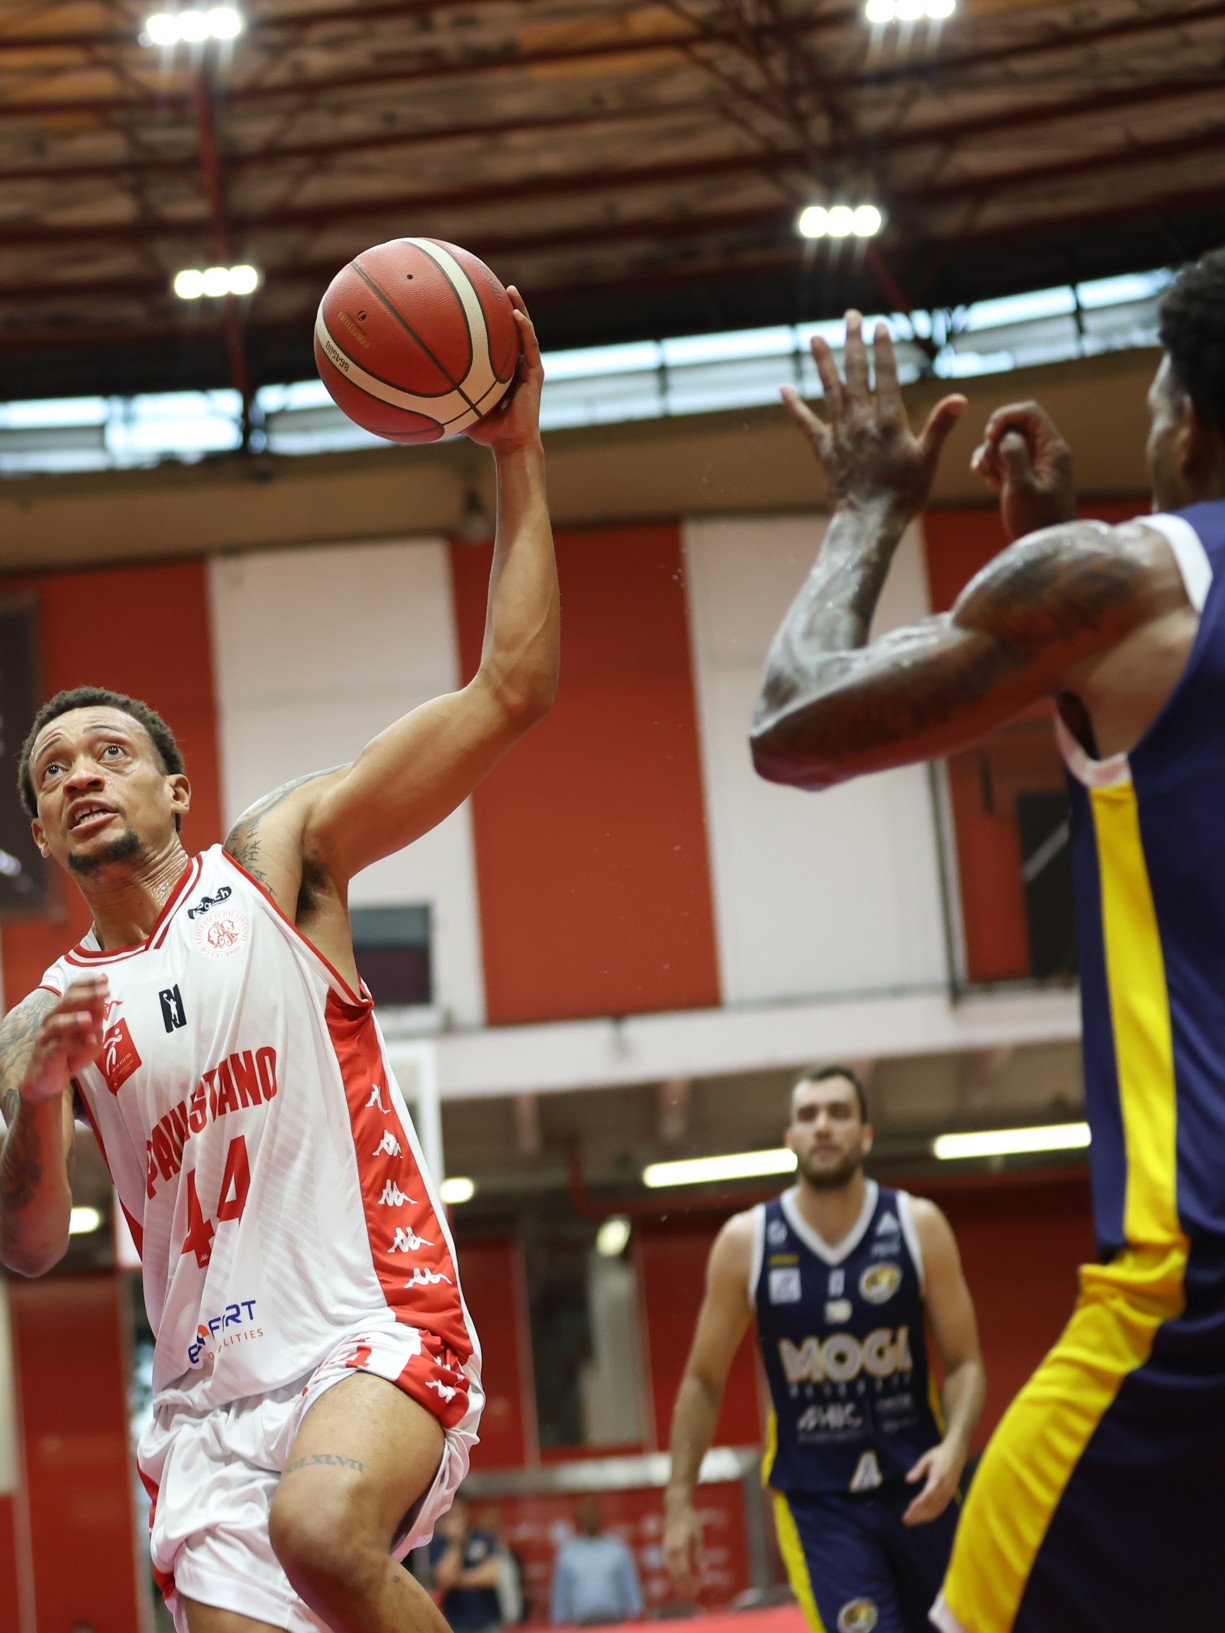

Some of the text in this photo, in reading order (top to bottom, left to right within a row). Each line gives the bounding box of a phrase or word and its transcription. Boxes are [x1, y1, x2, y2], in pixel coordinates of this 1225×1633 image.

[146, 1046, 278, 1200] PAULSTANO
[180, 1134, 251, 1270] 44
[778, 1323, 914, 1384] MOGI
